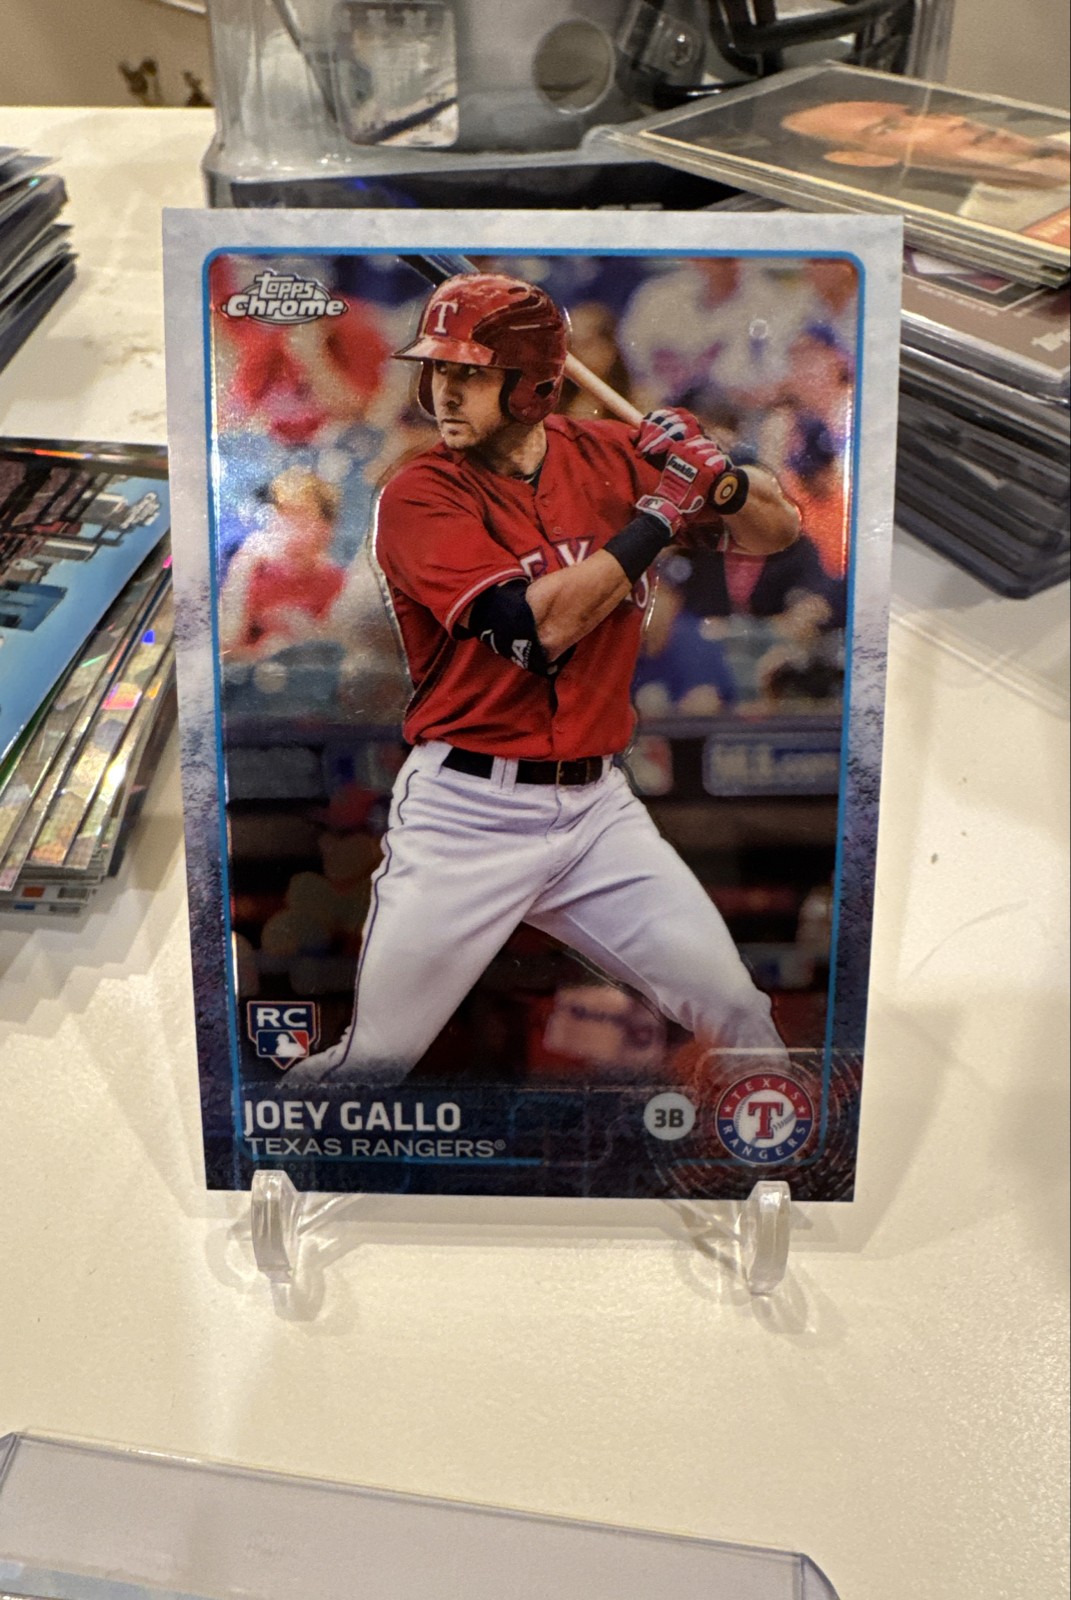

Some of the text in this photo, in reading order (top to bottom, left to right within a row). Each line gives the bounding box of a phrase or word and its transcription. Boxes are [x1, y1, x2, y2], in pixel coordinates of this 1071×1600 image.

[227, 294, 344, 317] Chrome
[432, 301, 459, 335] T
[257, 1007, 307, 1028] RC
[731, 1077, 802, 1101] TEXAS
[243, 1100, 461, 1137] JOEY GALLO
[654, 1108, 685, 1129] 3B
[747, 1101, 784, 1139] T
[244, 1137, 343, 1157] TEXAS
[722, 1125, 807, 1160] RANGERS
